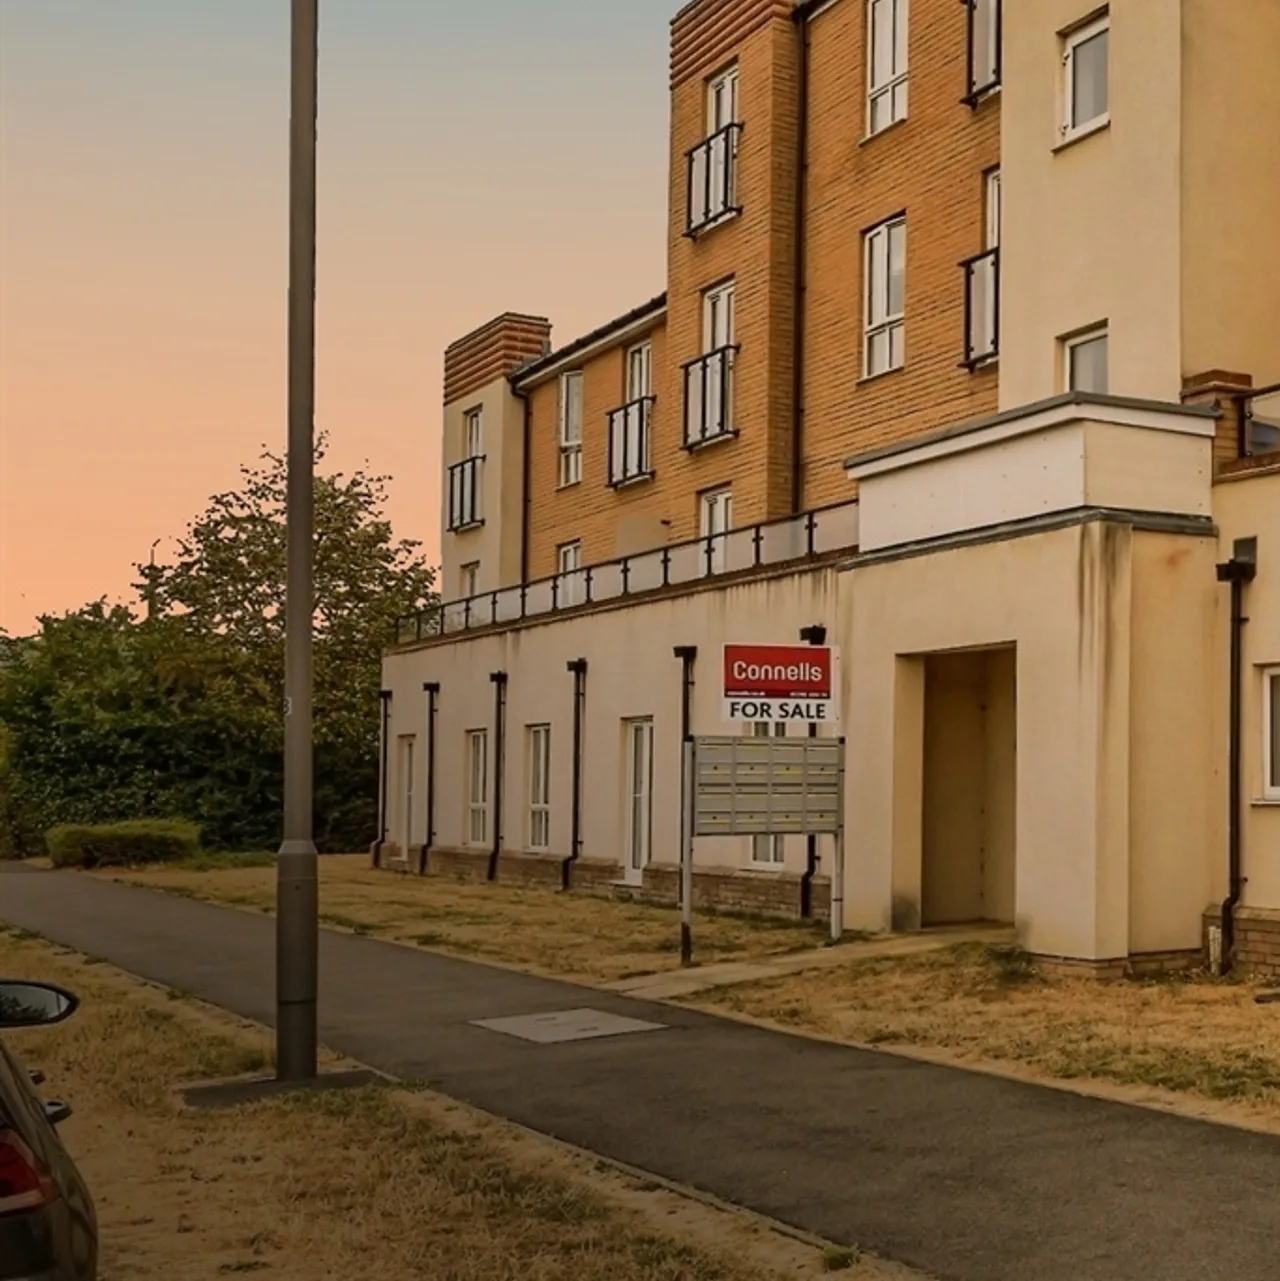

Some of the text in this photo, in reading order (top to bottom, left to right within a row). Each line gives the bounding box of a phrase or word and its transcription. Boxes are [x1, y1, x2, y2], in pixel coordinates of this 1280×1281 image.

[733, 661, 822, 681] Connells
[730, 702, 826, 719] FOR SALE
